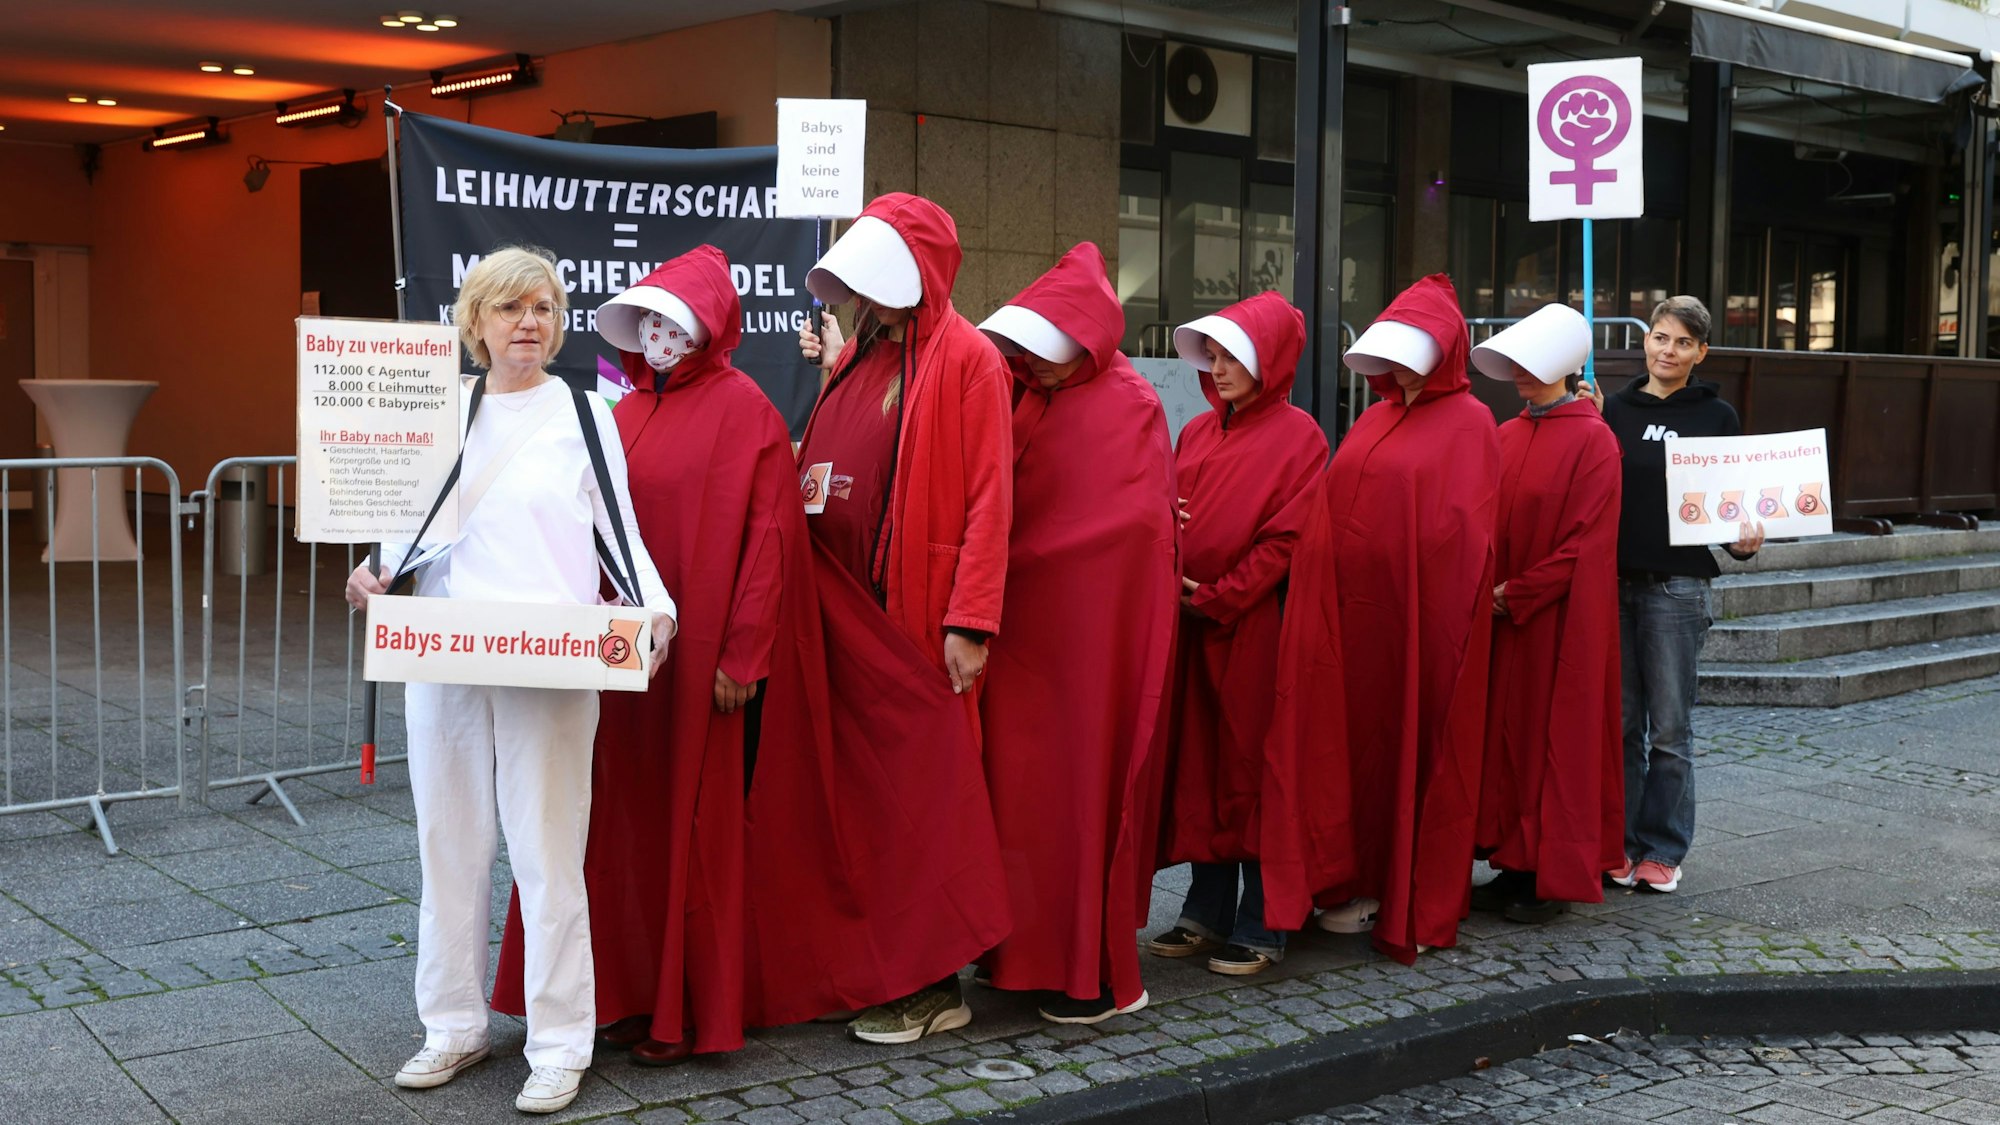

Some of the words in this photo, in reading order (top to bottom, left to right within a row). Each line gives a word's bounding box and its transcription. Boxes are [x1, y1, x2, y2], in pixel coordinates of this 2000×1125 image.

[801, 121, 843, 136] Babys
[806, 143, 836, 155] sind
[802, 164, 840, 177] keine
[436, 166, 777, 219] LEIHMUTTERSCHAF
[801, 186, 839, 199] Ware
[306, 334, 345, 357] Baby
[348, 340, 366, 353] zu
[370, 338, 452, 357] verkaufen!
[313, 364, 363, 376] 112.000
[367, 366, 376, 376] €
[378, 366, 431, 379] Agentur
[328, 381, 363, 392] 8.000
[367, 381, 376, 392] €
[379, 382, 447, 394] Leihmutter
[313, 396, 363, 408] 120.000
[367, 397, 376, 408] €
[320, 430, 336, 441] Ihr
[340, 430, 370, 445] Baby
[374, 432, 402, 443] nach
[406, 431, 434, 444] Maß!
[329, 446, 378, 456] Geschlecht,
[380, 446, 423, 456] Haarfarbe,
[1672, 453, 1719, 467] Babys
[1723, 453, 1740, 464] zu
[1745, 444, 1822, 463] verkaufen
[329, 456, 381, 466] Körpergröße
[383, 457, 399, 465] und
[401, 457, 411, 466] IQ
[329, 467, 350, 475] nach
[329, 477, 373, 486] Risikofreie
[375, 478, 420, 488] Bestellung!
[329, 488, 382, 497] Behinderung
[384, 488, 402, 497] oder
[329, 498, 364, 507] falsches
[329, 508, 375, 518] Abtreibung
[377, 508, 389, 517] bis
[400, 509, 426, 518] Monat
[375, 624, 442, 657] Babys
[450, 634, 475, 653] zu
